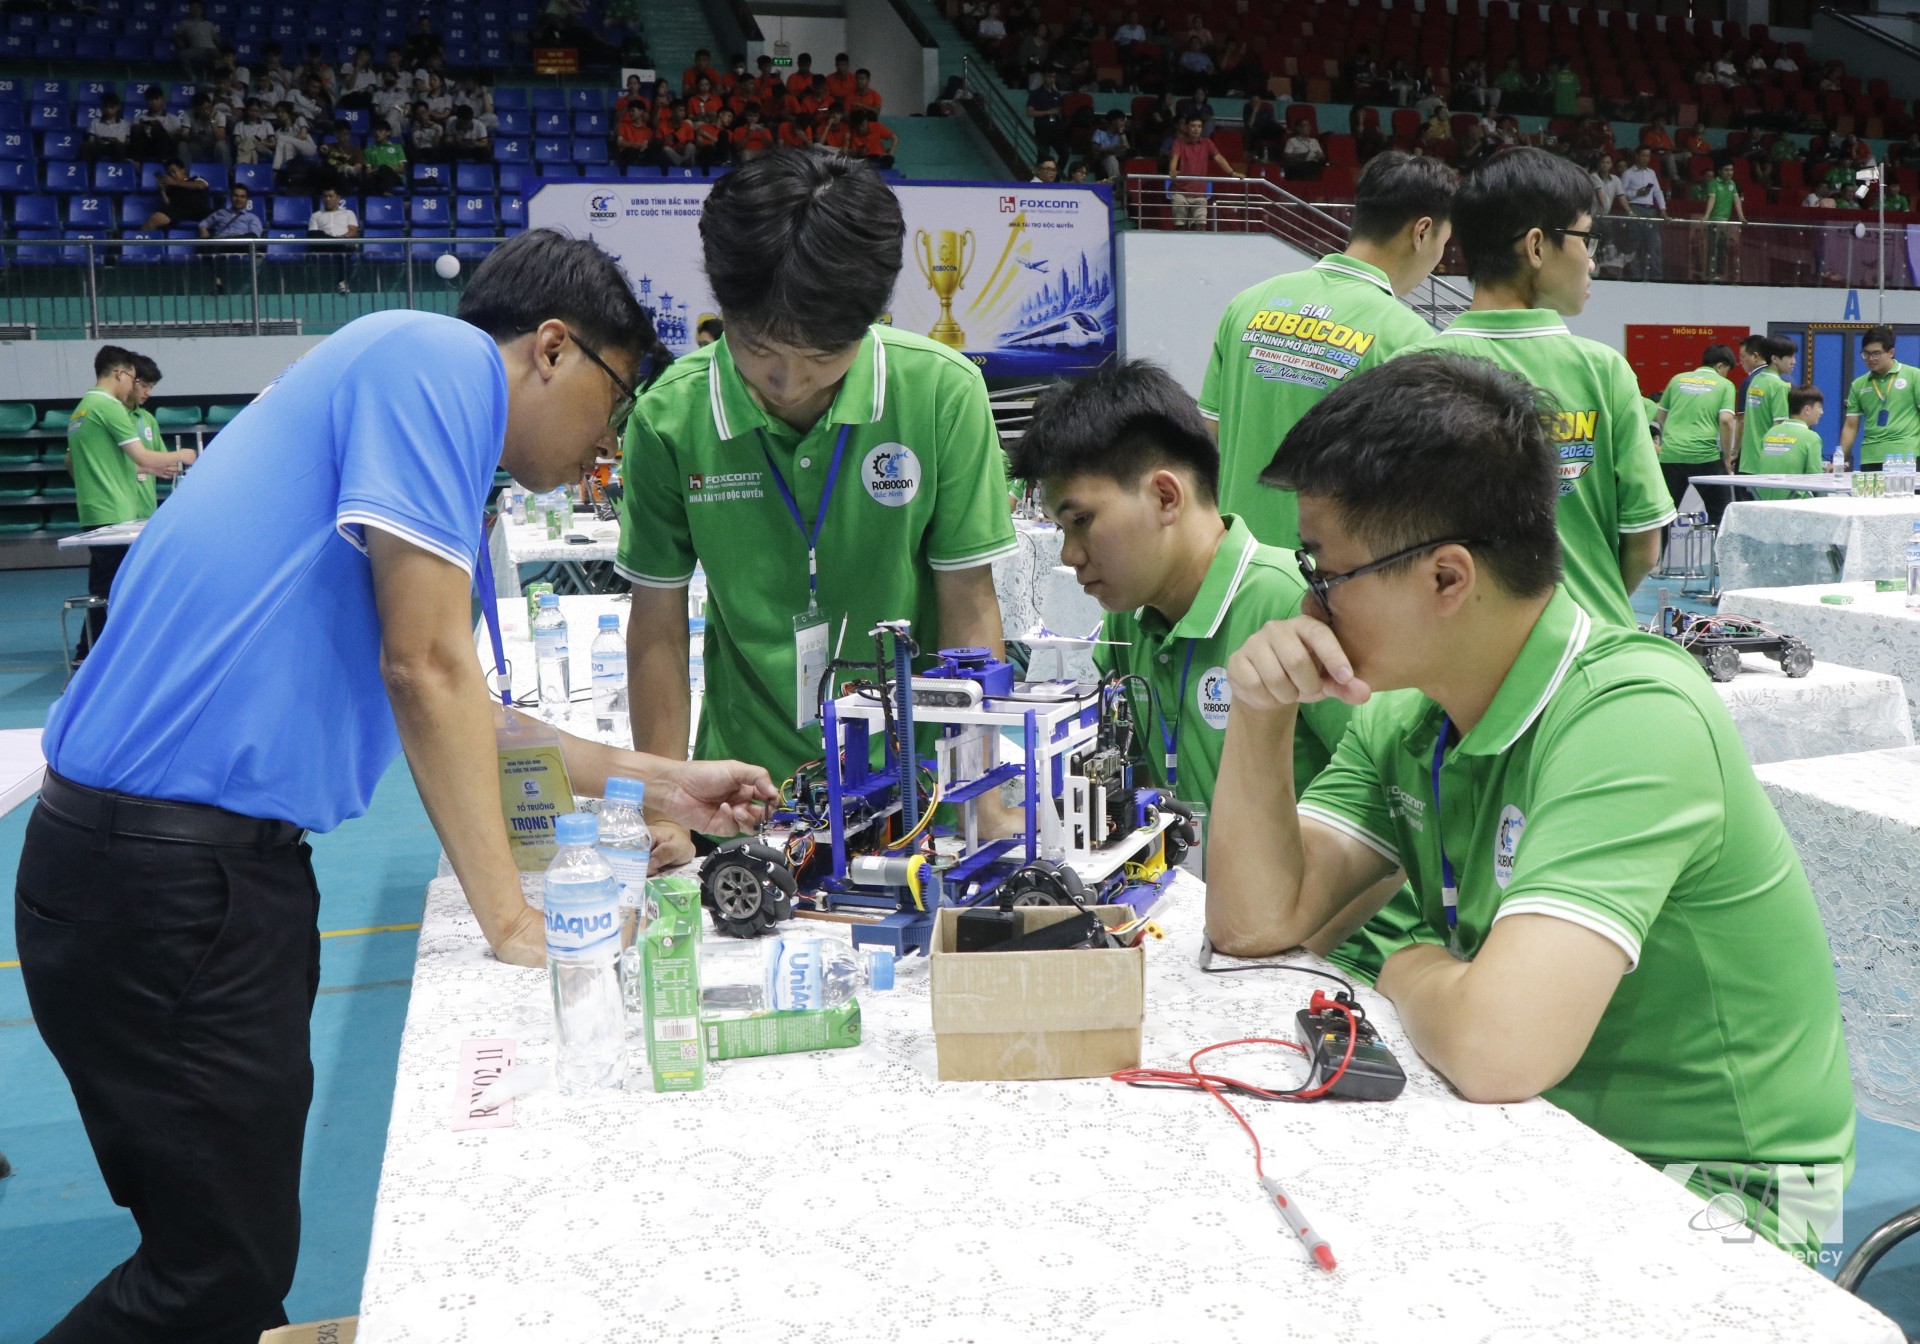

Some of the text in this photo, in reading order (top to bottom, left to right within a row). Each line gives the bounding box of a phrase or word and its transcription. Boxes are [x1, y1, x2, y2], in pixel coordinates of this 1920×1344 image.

[6, 135, 21, 146] 20
[425, 167, 439, 178] 38
[82, 200, 98, 210] 22
[423, 199, 437, 210] 36
[1299, 304, 1333, 319] GIẢI
[1844, 290, 1861, 320] A
[1246, 310, 1376, 356] ROBOCON
[1672, 327, 1696, 335] THÔNG
[1241, 330, 1260, 342] BẮC
[1259, 334, 1285, 347] NINH
[1301, 343, 1327, 357] RỘNG
[1325, 348, 1361, 367] 2026
[1254, 348, 1281, 360] TRANH
[1301, 359, 1339, 375] FOXCONN
[1560, 444, 1595, 459] 2026
[871, 478, 914, 491] ROBOCON
[689, 492, 703, 503] NHÀ
[517, 801, 526, 812] TỔ
[511, 815, 549, 833] TRỌNG
